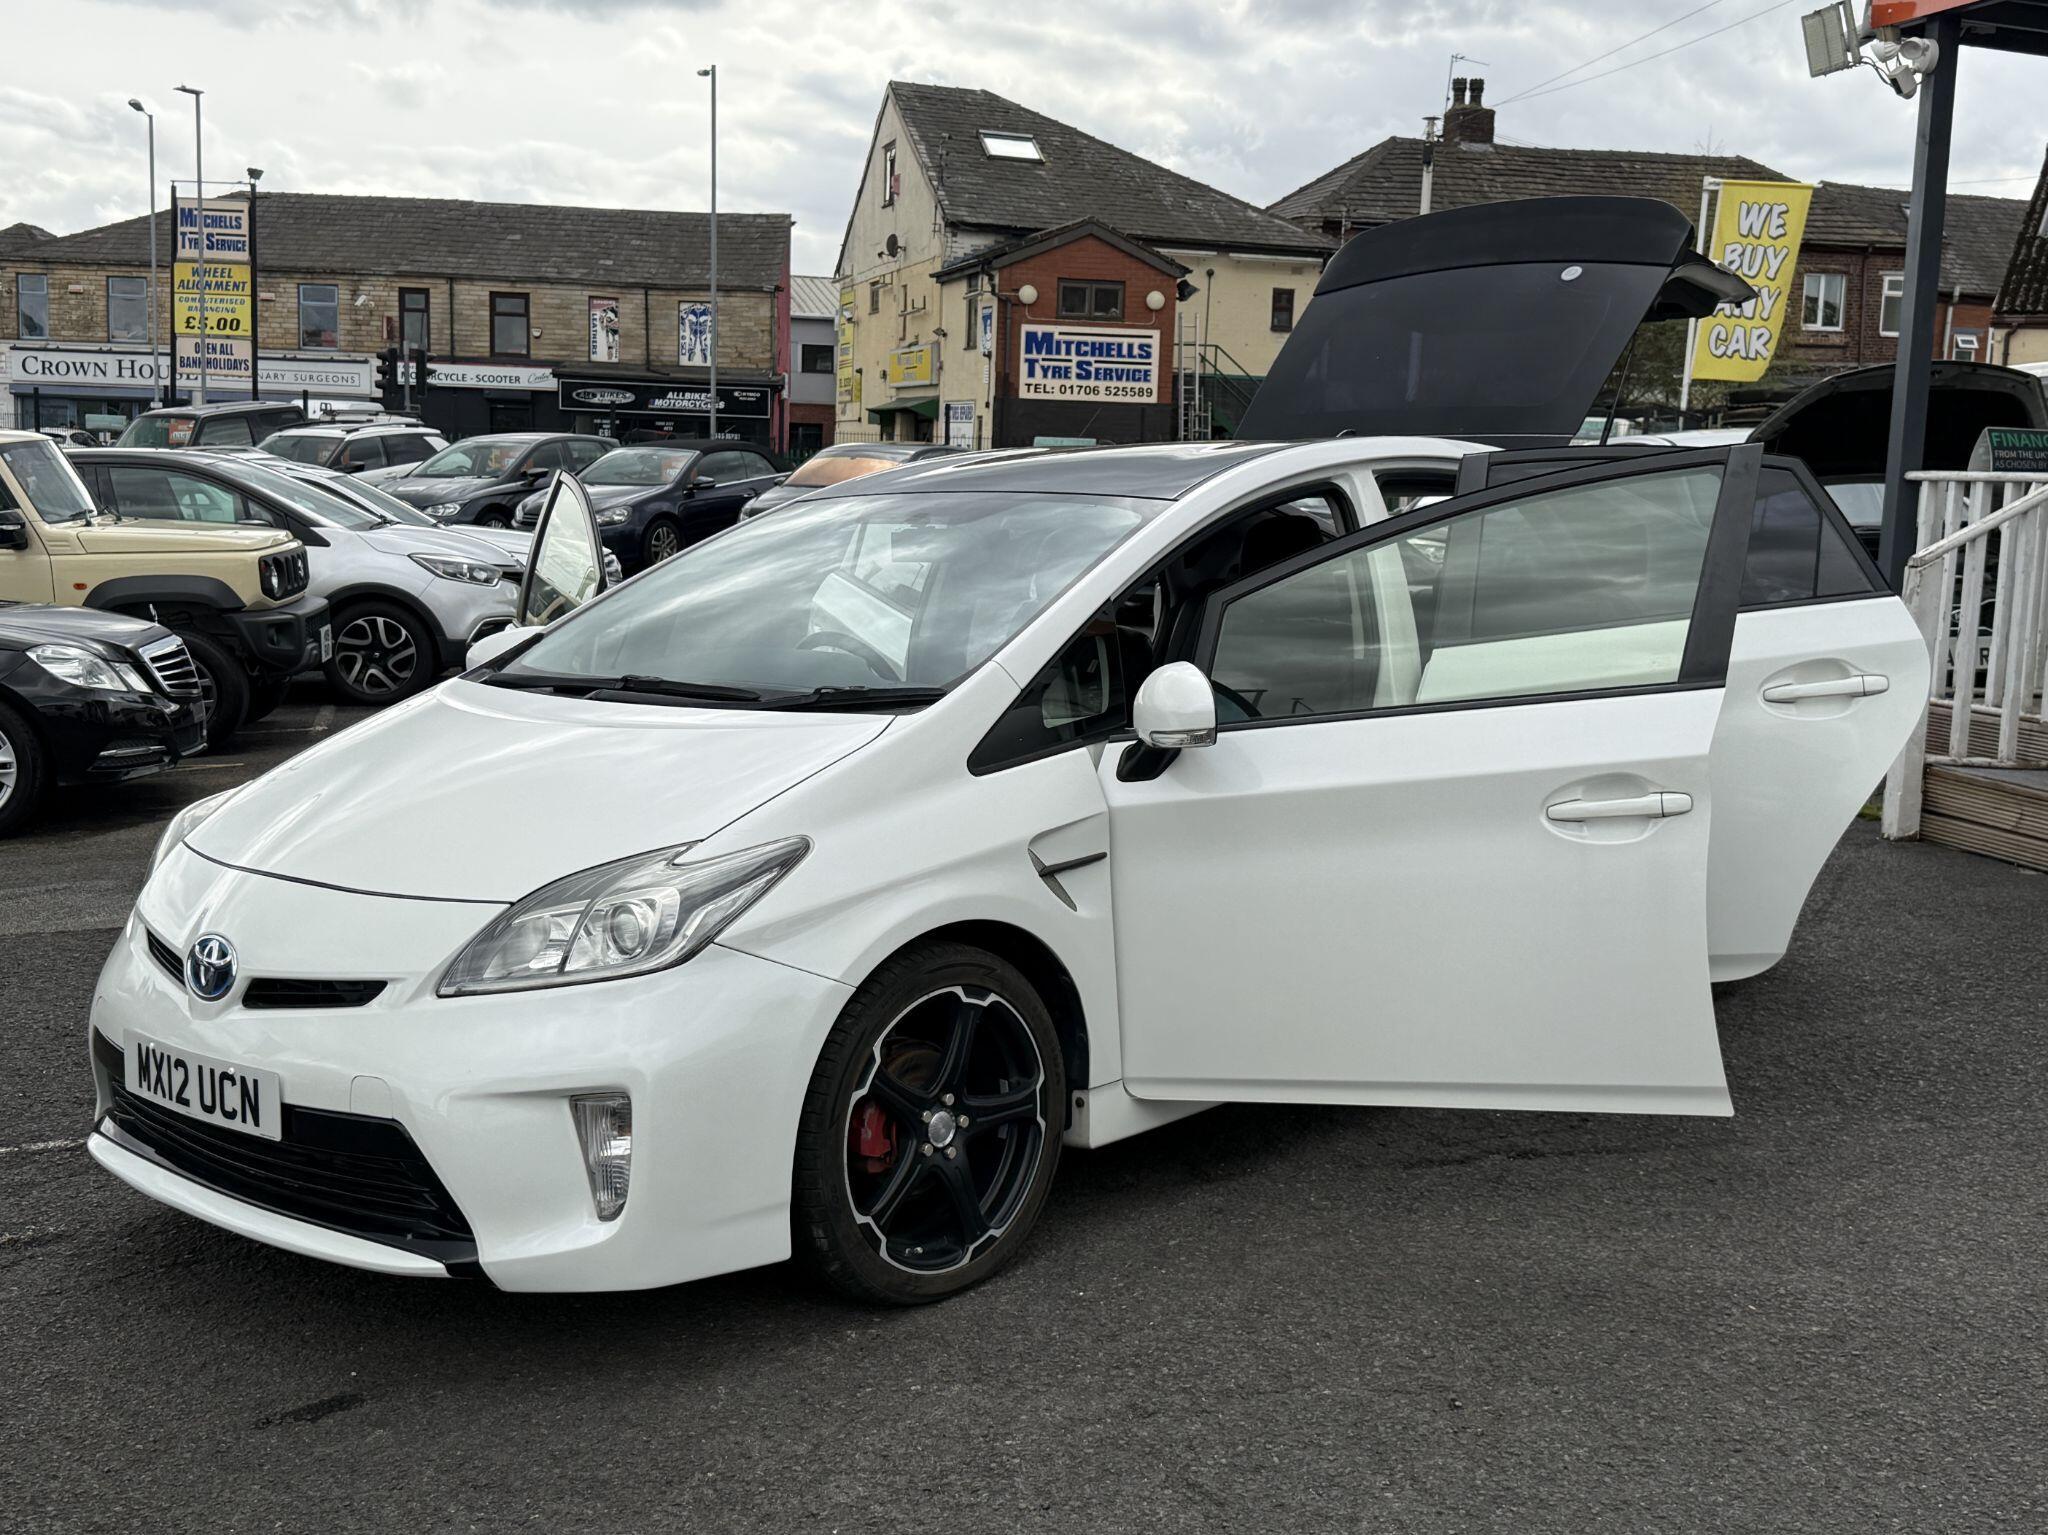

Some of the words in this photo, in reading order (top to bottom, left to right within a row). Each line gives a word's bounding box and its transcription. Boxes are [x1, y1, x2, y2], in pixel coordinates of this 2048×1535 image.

[180, 208, 242, 230] MICHELLS
[1738, 200, 1789, 240] WE
[180, 231, 204, 250] TYR
[206, 233, 247, 252] SERVICE
[1723, 242, 1789, 281] BUY
[191, 266, 233, 279] WHEEL
[187, 305, 237, 314] BAANCING
[194, 341, 217, 355] OEN
[219, 343, 234, 356] ALL
[1024, 331, 1153, 359] MITCHELLS
[1708, 324, 1772, 360] CAR
[21, 355, 107, 378] CROWN
[116, 359, 199, 380] HOU
[180, 356, 204, 369] BAN
[206, 357, 250, 371] HOLIDAYS
[1024, 358, 1071, 380] TYRE
[1075, 360, 1152, 382] SERVICE
[294, 374, 356, 384] SURGEONS
[400, 371, 467, 382] MORCYCLE
[475, 374, 521, 384] SCOOTER
[1025, 383, 1055, 394] TEL:
[1059, 385, 1100, 395] 01706
[1104, 386, 1153, 397] 525589
[1994, 449, 2017, 458] FROM
[2018, 450, 2033, 459] THE
[137, 1042, 191, 1108] MX12
[198, 1065, 260, 1127] UCN
